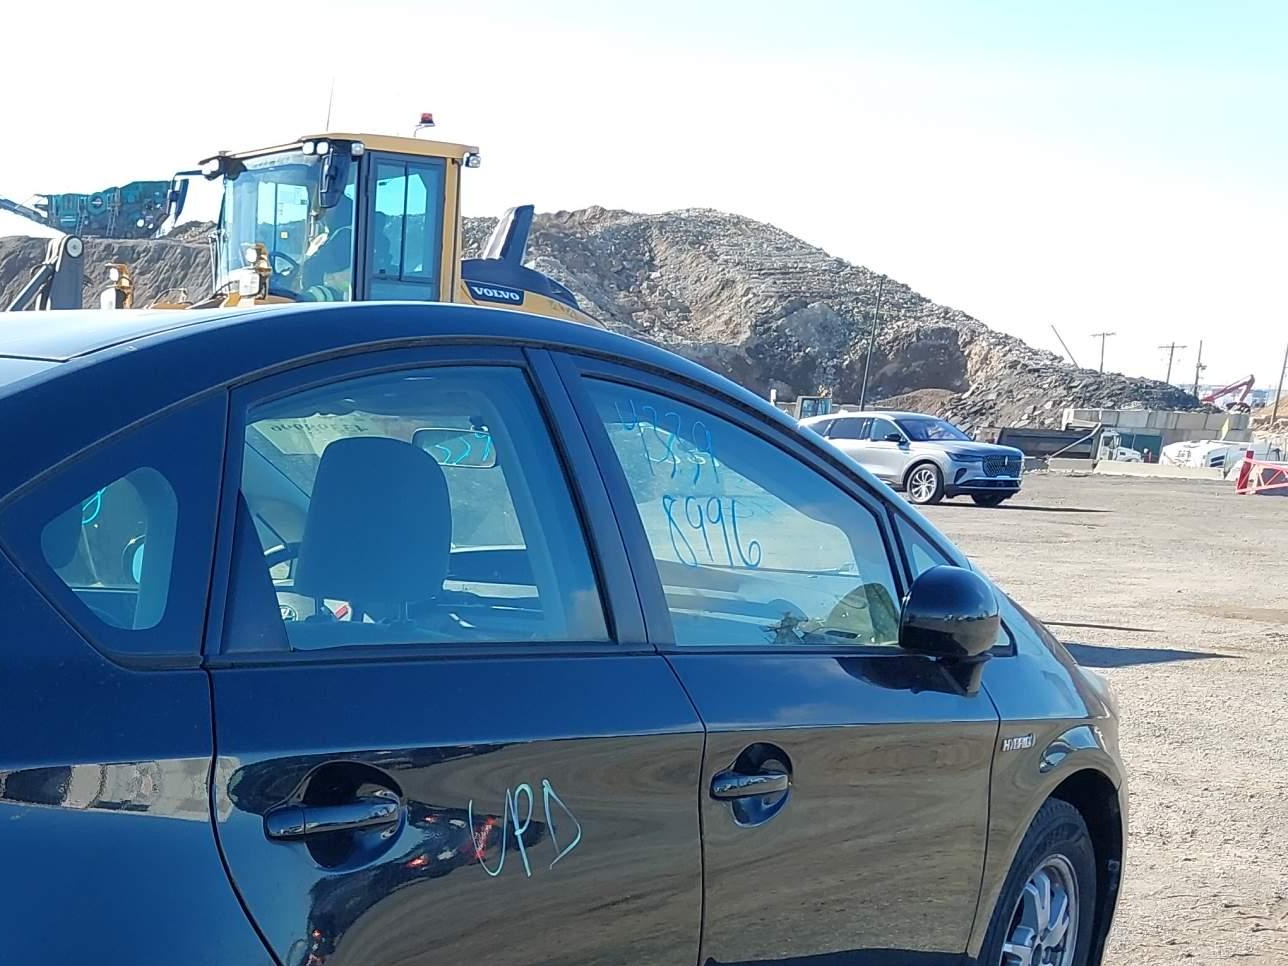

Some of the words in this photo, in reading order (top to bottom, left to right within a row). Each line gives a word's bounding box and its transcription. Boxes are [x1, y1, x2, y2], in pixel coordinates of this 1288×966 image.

[471, 286, 520, 301] VOLVO
[662, 494, 762, 569] 8996
[468, 779, 582, 878] UPD
